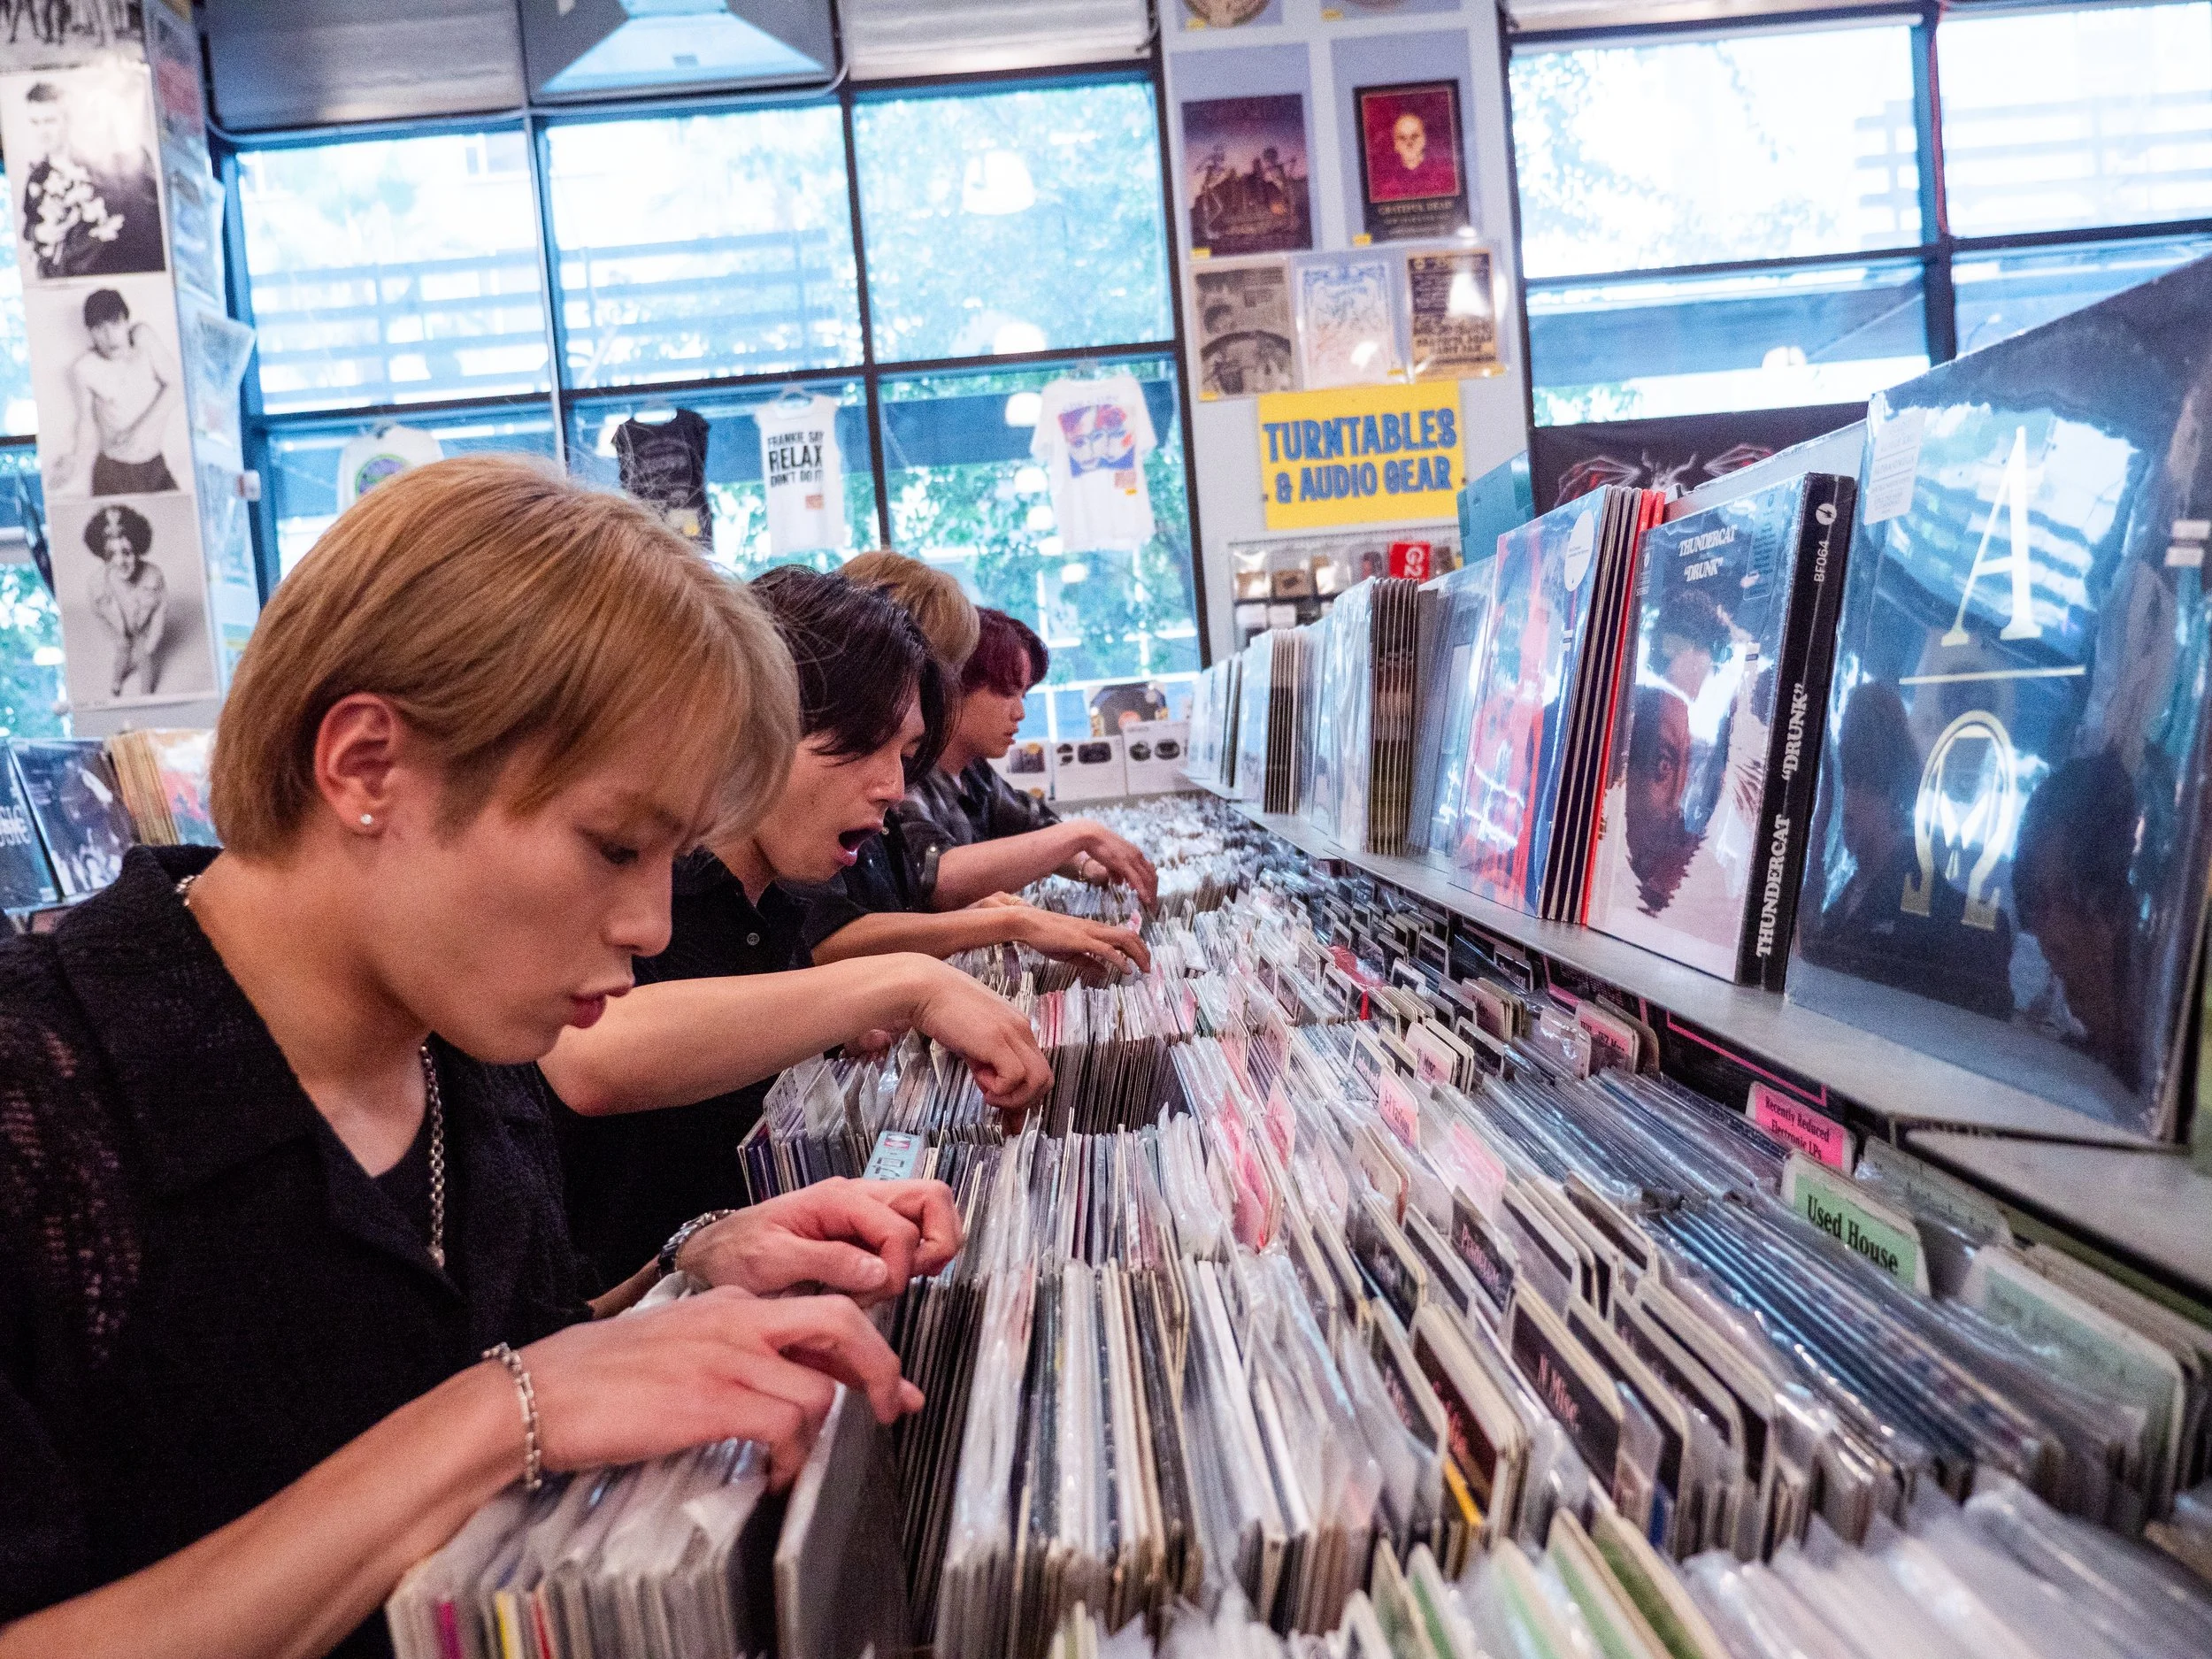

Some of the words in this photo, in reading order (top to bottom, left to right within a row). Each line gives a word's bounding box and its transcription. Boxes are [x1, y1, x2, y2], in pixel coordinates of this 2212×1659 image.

[769, 445, 822, 472] RELAX
[1263, 408, 1457, 462] TURNTABLES
[1275, 472, 1293, 503] &
[1300, 461, 1378, 503] AUDIO
[1384, 456, 1453, 495] GEAR
[1679, 524, 1738, 557] THUNDERCAT
[1814, 540, 1830, 582] BF064
[1756, 814, 1790, 958] THUNDERCAT
[1765, 1095, 1796, 1129] Recently
[1797, 1111, 1830, 1143] Reduced
[1771, 1118, 1807, 1148] Electronic
[1808, 1141, 1822, 1160] LPs
[1807, 1194, 1842, 1240] Used
[1847, 1218, 1899, 1276] House
